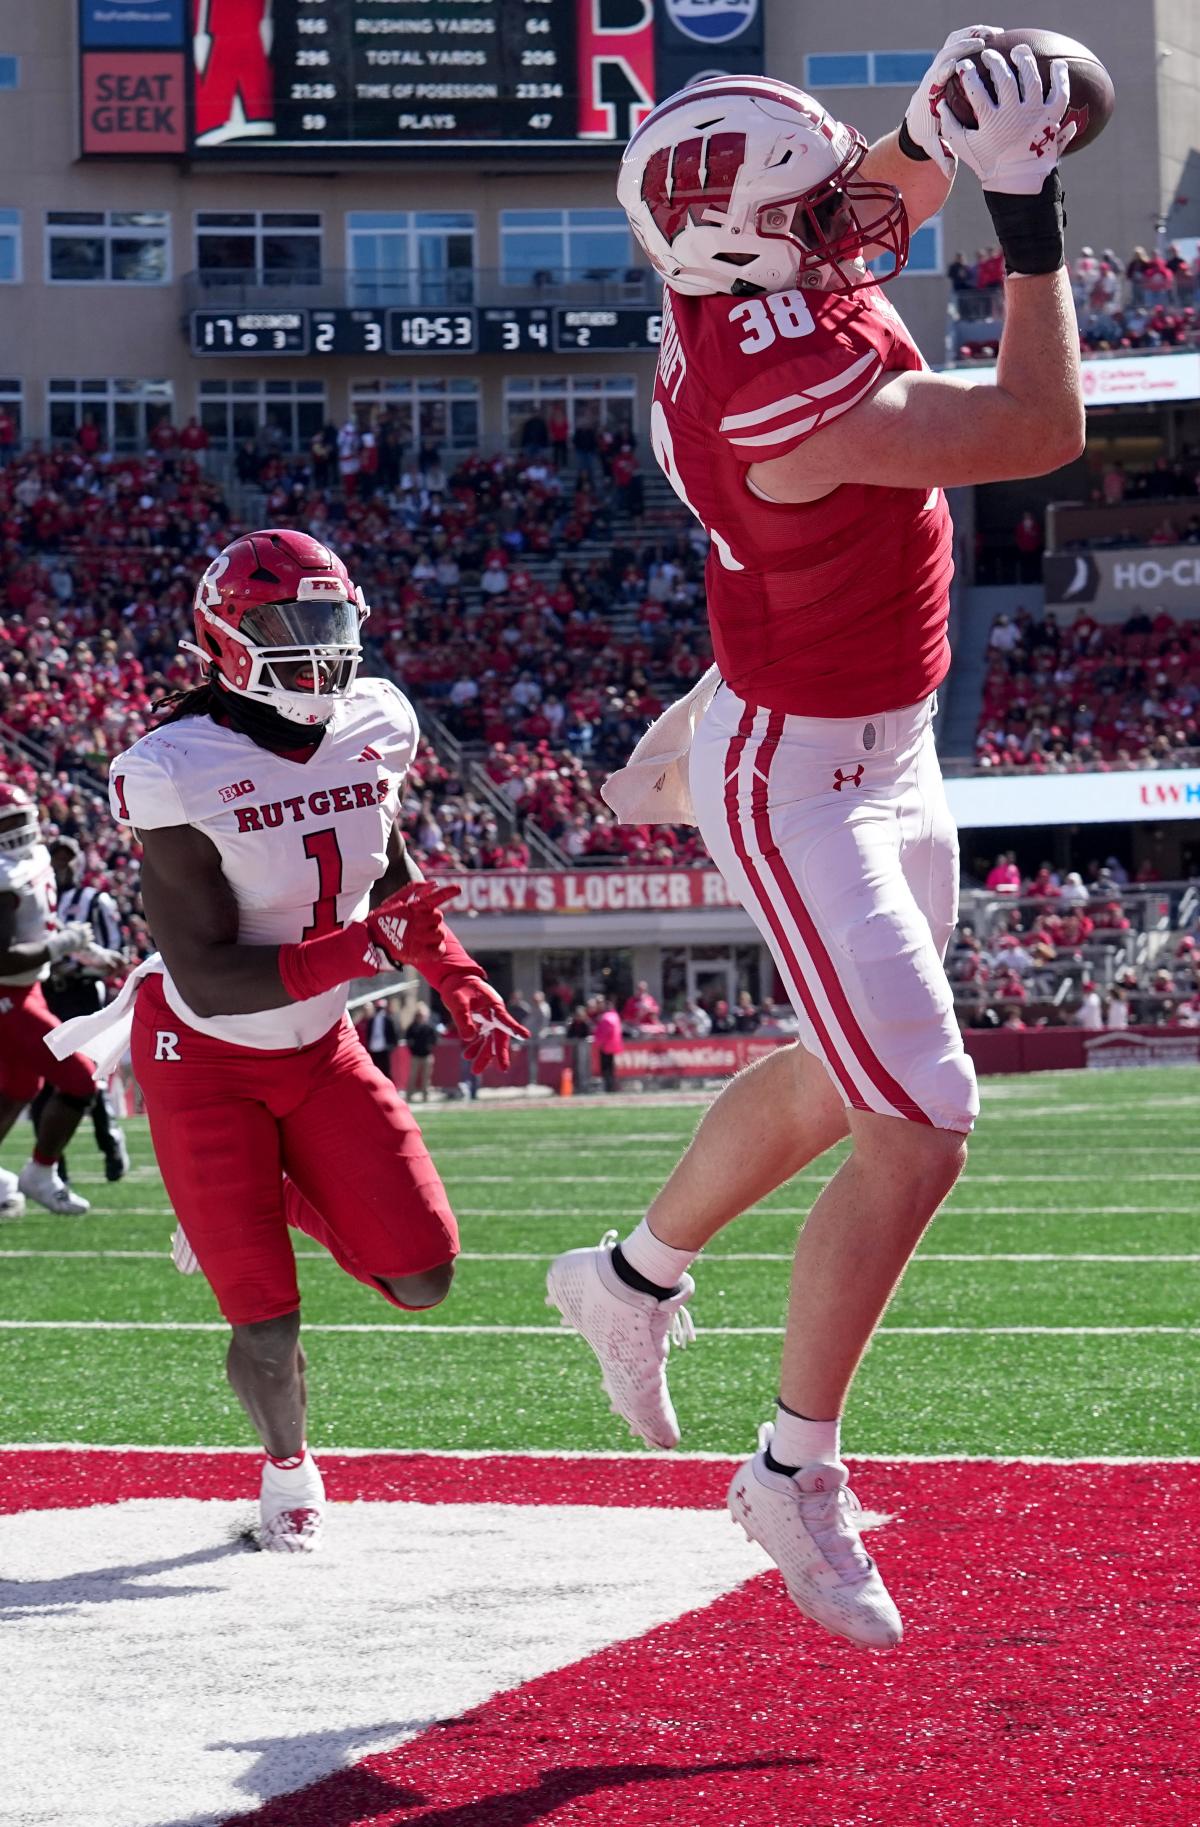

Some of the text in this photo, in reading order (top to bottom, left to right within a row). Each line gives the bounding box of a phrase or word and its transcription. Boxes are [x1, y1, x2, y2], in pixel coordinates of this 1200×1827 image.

[297, 19, 550, 33] 166 RUSHING YARDS 64
[296, 51, 556, 65] 296 TOTAL YARDS 206
[97, 75, 172, 101] SEAT
[355, 84, 391, 98] TIME
[392, 84, 414, 98] OF
[91, 106, 176, 134] GEEK
[399, 114, 456, 129] PLAYS
[528, 114, 552, 129] 47
[205, 319, 233, 345] 17
[402, 317, 472, 345] 10:53
[502, 322, 520, 350] 3
[528, 324, 547, 347] 4
[728, 289, 816, 355] 38
[316, 323, 335, 351] 2
[364, 323, 381, 351] 3
[1113, 560, 1200, 590] HO-C
[114, 775, 130, 820] 1
[234, 779, 389, 833] RUTGERS
[302, 827, 344, 943] 1
[563, 872, 691, 908] LOCKER
[703, 871, 742, 906] R
[154, 1031, 181, 1060] R
